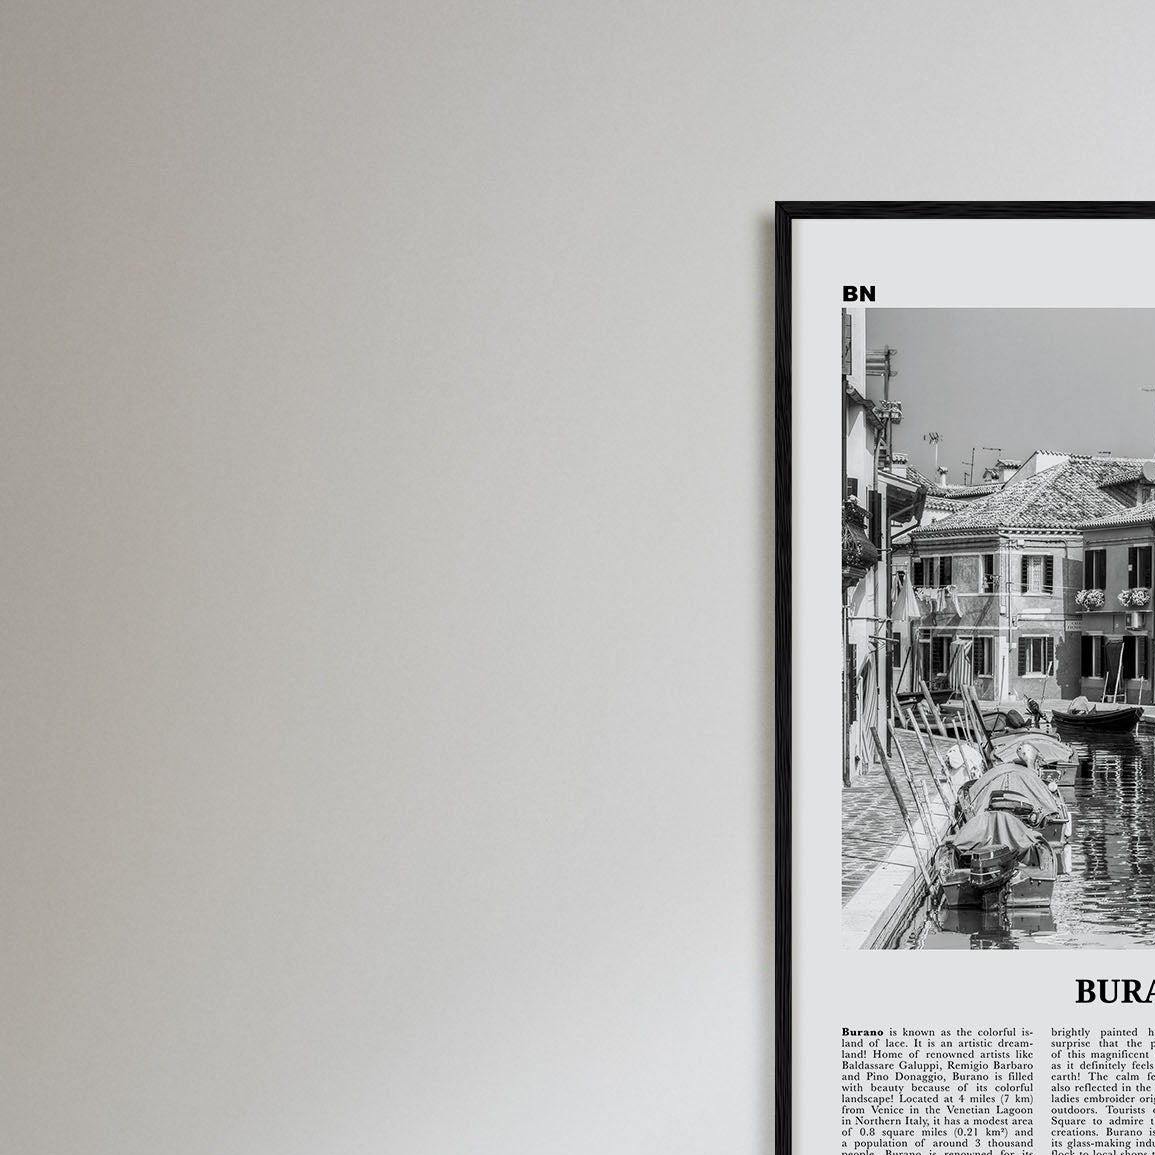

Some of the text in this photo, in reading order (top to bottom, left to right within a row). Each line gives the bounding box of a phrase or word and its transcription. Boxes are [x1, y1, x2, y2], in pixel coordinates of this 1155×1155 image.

[843, 286, 875, 301] BN
[842, 1028, 884, 1036] Burano
[889, 1028, 898, 1036] is
[902, 1028, 935, 1036] known
[956, 1028, 972, 1036] the
[977, 1028, 1016, 1036] colorful
[1021, 1028, 1034, 1036] is-
[1051, 1028, 1091, 1038] brightly
[1100, 1028, 1138, 1038] painted
[841, 1039, 864, 1048] land
[868, 1039, 879, 1048] of
[885, 1039, 908, 1048] lace.
[914, 1039, 922, 1048] It
[927, 1039, 936, 1048] is
[958, 1039, 993, 1048] artistic
[997, 1039, 1034, 1048] dream-
[1051, 1050, 1061, 1059] of
[1068, 1050, 1087, 1059] this
[1091, 1050, 1149, 1061] magnificent
[842, 1061, 1034, 1072] Baldassare Galuppi, Remigio Barbaro
[1067, 1061, 1074, 1070] it
[1079, 1061, 1127, 1072] definitely
[1132, 1061, 1154, 1070] feels
[841, 1072, 1034, 1083] and Pino Donaggio, Burano is filled
[1051, 1083, 1071, 1092] also
[1075, 1083, 1118, 1092] reflected
[1122, 1083, 1132, 1092] in
[1136, 1083, 1152, 1092] the
[842, 1095, 1034, 1105] landscape! Located at 4 miles (7 km)
[1051, 1106, 1098, 1114] outdoors.
[1106, 1106, 1146, 1114] Tourists
[841, 1117, 852, 1125] in
[855, 1117, 902, 1125] Northern
[905, 1117, 930, 1127] Italy,
[933, 1117, 941, 1125] it
[944, 1117, 961, 1125] has
[973, 1117, 1009, 1125] modest
[1051, 1117, 1086, 1127] Square
[1109, 1117, 1144, 1125] admire
[854, 1139, 908, 1149] population
[914, 1139, 924, 1147] of
[932, 1139, 969, 1147] around
[975, 1139, 981, 1147] 3
[988, 1139, 1034, 1147] thousand
[1051, 1139, 1063, 1147] its
[1067, 1139, 1132, 1149] glass-making
